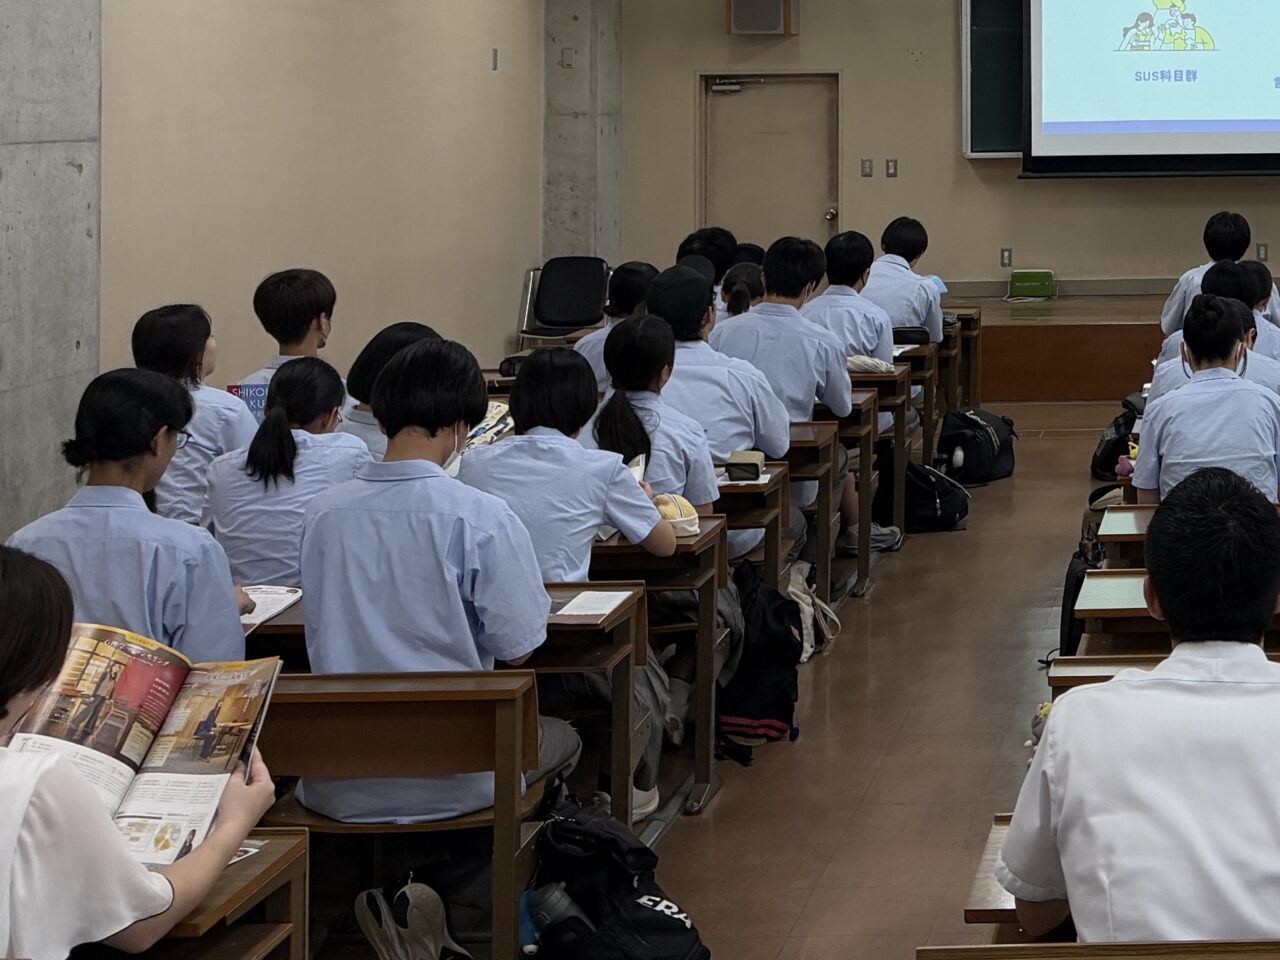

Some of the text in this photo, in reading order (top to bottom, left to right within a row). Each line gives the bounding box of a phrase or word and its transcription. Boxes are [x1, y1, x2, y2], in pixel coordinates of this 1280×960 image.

[1134, 69, 1198, 83] SUS科目群
[232, 387, 269, 397] SHIKO
